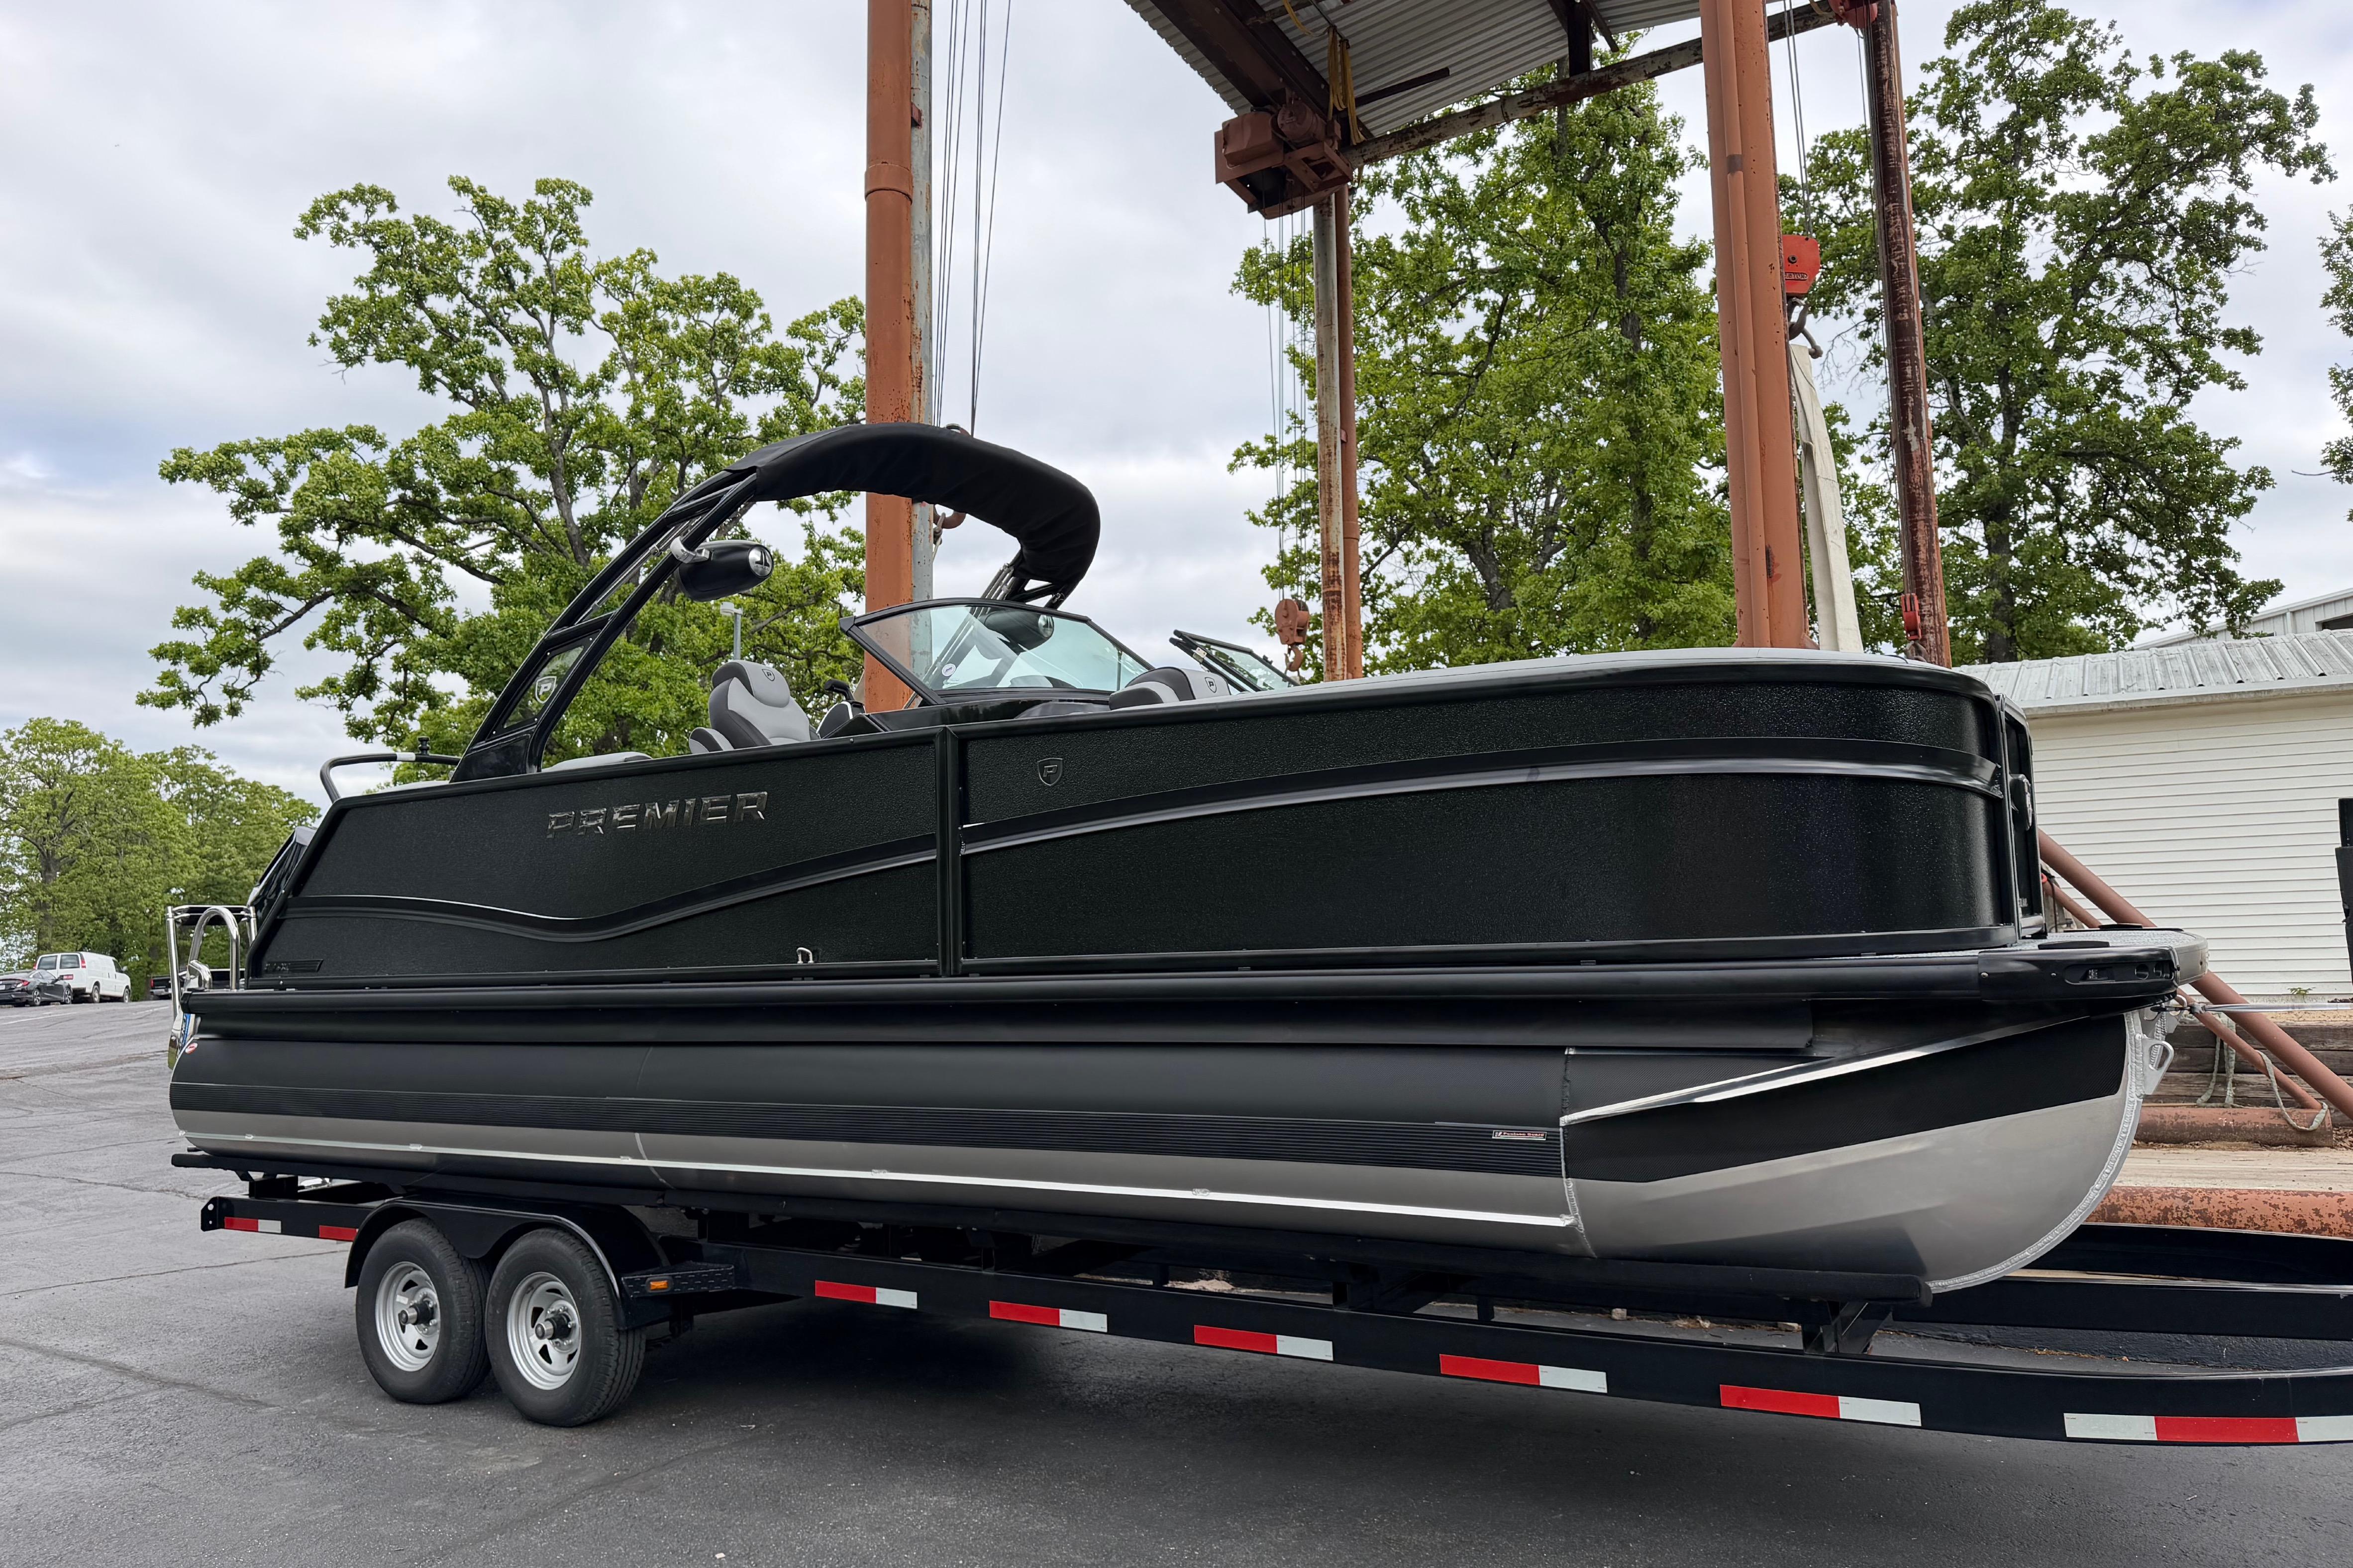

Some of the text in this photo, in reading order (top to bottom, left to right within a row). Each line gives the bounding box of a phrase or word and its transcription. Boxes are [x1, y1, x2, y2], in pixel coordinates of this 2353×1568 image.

[539, 683, 552, 695] P
[1043, 765, 1057, 777] P
[547, 791, 768, 838] PREMIER
